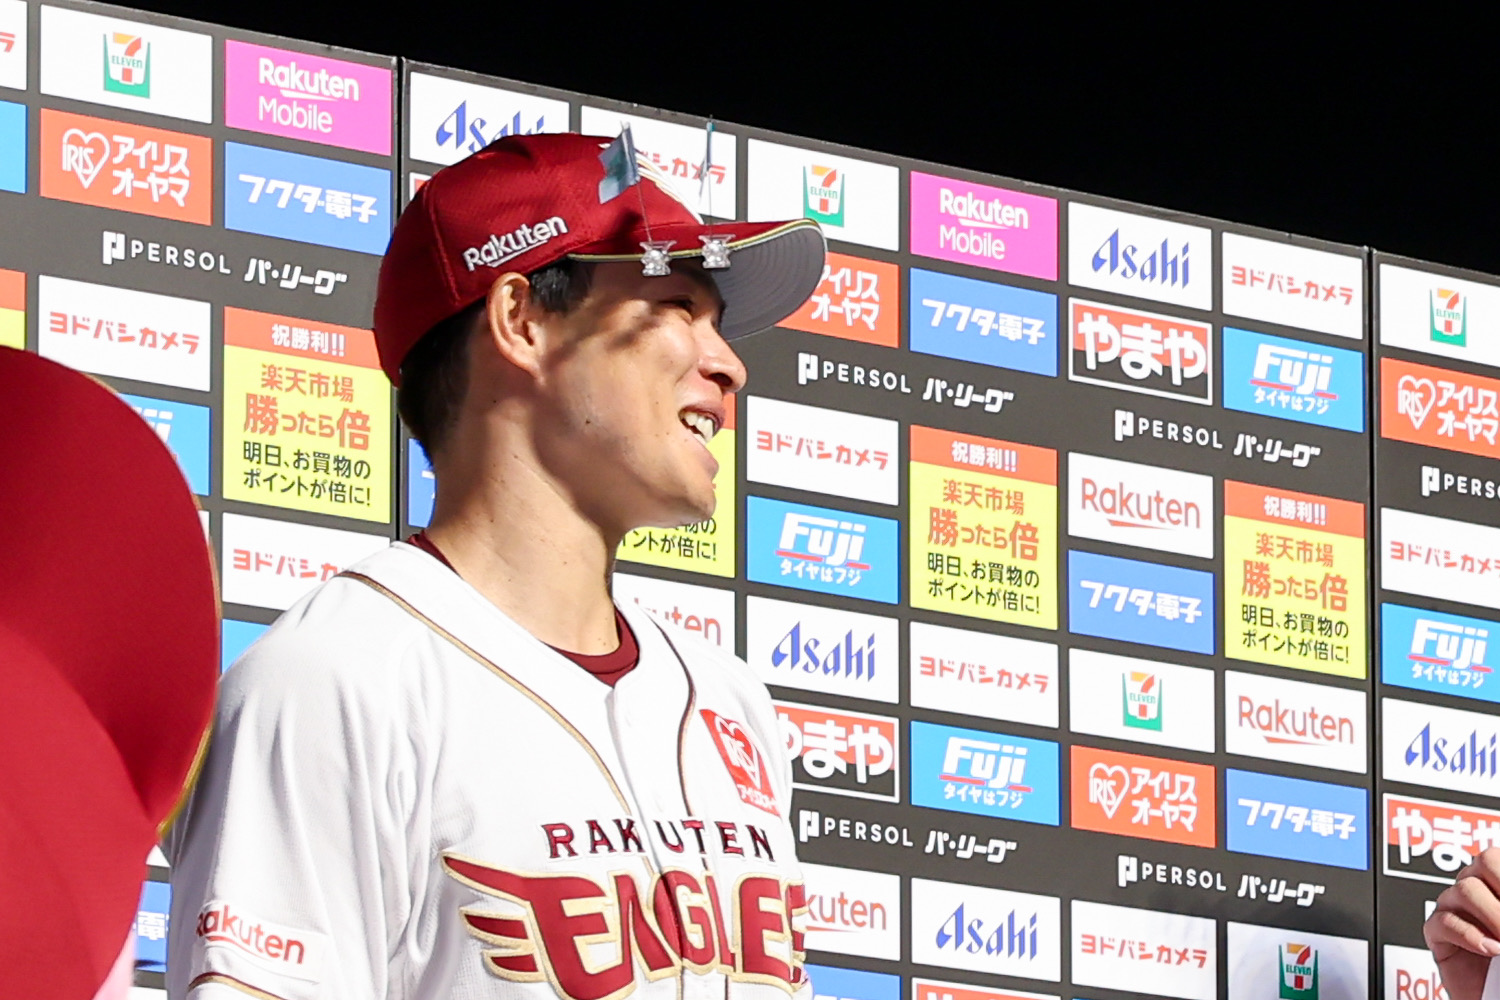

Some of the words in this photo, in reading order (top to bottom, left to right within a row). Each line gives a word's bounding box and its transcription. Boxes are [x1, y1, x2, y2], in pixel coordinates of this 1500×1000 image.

[257, 56, 359, 100] Rakuten
[257, 94, 332, 134] Mobile
[112, 134, 191, 177] アイリス
[112, 166, 190, 208] オーヤマ
[942, 186, 1030, 227] Rakuten
[131, 240, 230, 274] PERSOL
[463, 216, 569, 270] Rakuten
[941, 222, 1008, 260] Mobile
[1091, 222, 1189, 290] Asahi
[1233, 266, 1353, 305] ヨドバシカメラ
[50, 312, 199, 355] ヨドバシカメラ
[1077, 309, 1207, 391] やまや
[259, 362, 352, 403] 楽天市場
[821, 360, 910, 394] PERSOL
[1251, 343, 1334, 396] Fuji
[1253, 388, 1328, 415] タイヤはフジ
[1438, 380, 1500, 417] アイリス
[243, 391, 369, 452] 勝ったら倍
[1138, 418, 1223, 449] PERSOL
[1438, 408, 1500, 445] オーヤマ
[243, 439, 370, 483] 明日、お買物の
[758, 431, 889, 470] ヨドバシカメラ
[942, 478, 1024, 517] 楽天市場
[1080, 475, 1200, 531] Rakuten
[777, 511, 866, 566] Fuji
[927, 505, 1039, 563] 勝ったら倍
[1255, 530, 1335, 567] 楽天市場
[779, 558, 861, 586] タイヤはフジ
[1241, 556, 1350, 611] 勝ったら倍
[1241, 601, 1351, 639] 明日、お買物の
[772, 625, 875, 679] Asahi
[1408, 618, 1488, 669] Fuji
[921, 657, 1049, 694] ヨドバシカメラ
[1238, 693, 1353, 746] Rakuten
[938, 737, 1026, 789] Fuji
[1406, 726, 1497, 775] Asahi
[941, 782, 1022, 809] タイヤはフジ
[1130, 766, 1196, 803] アイリス
[824, 817, 913, 847] PERSOL
[1129, 796, 1196, 832] オーヤマ
[541, 817, 774, 862] RAKUTEN
[1141, 862, 1226, 891] PERSOL
[936, 906, 1037, 958] Asahi
[1082, 934, 1207, 969] ヨドバシカメラ
